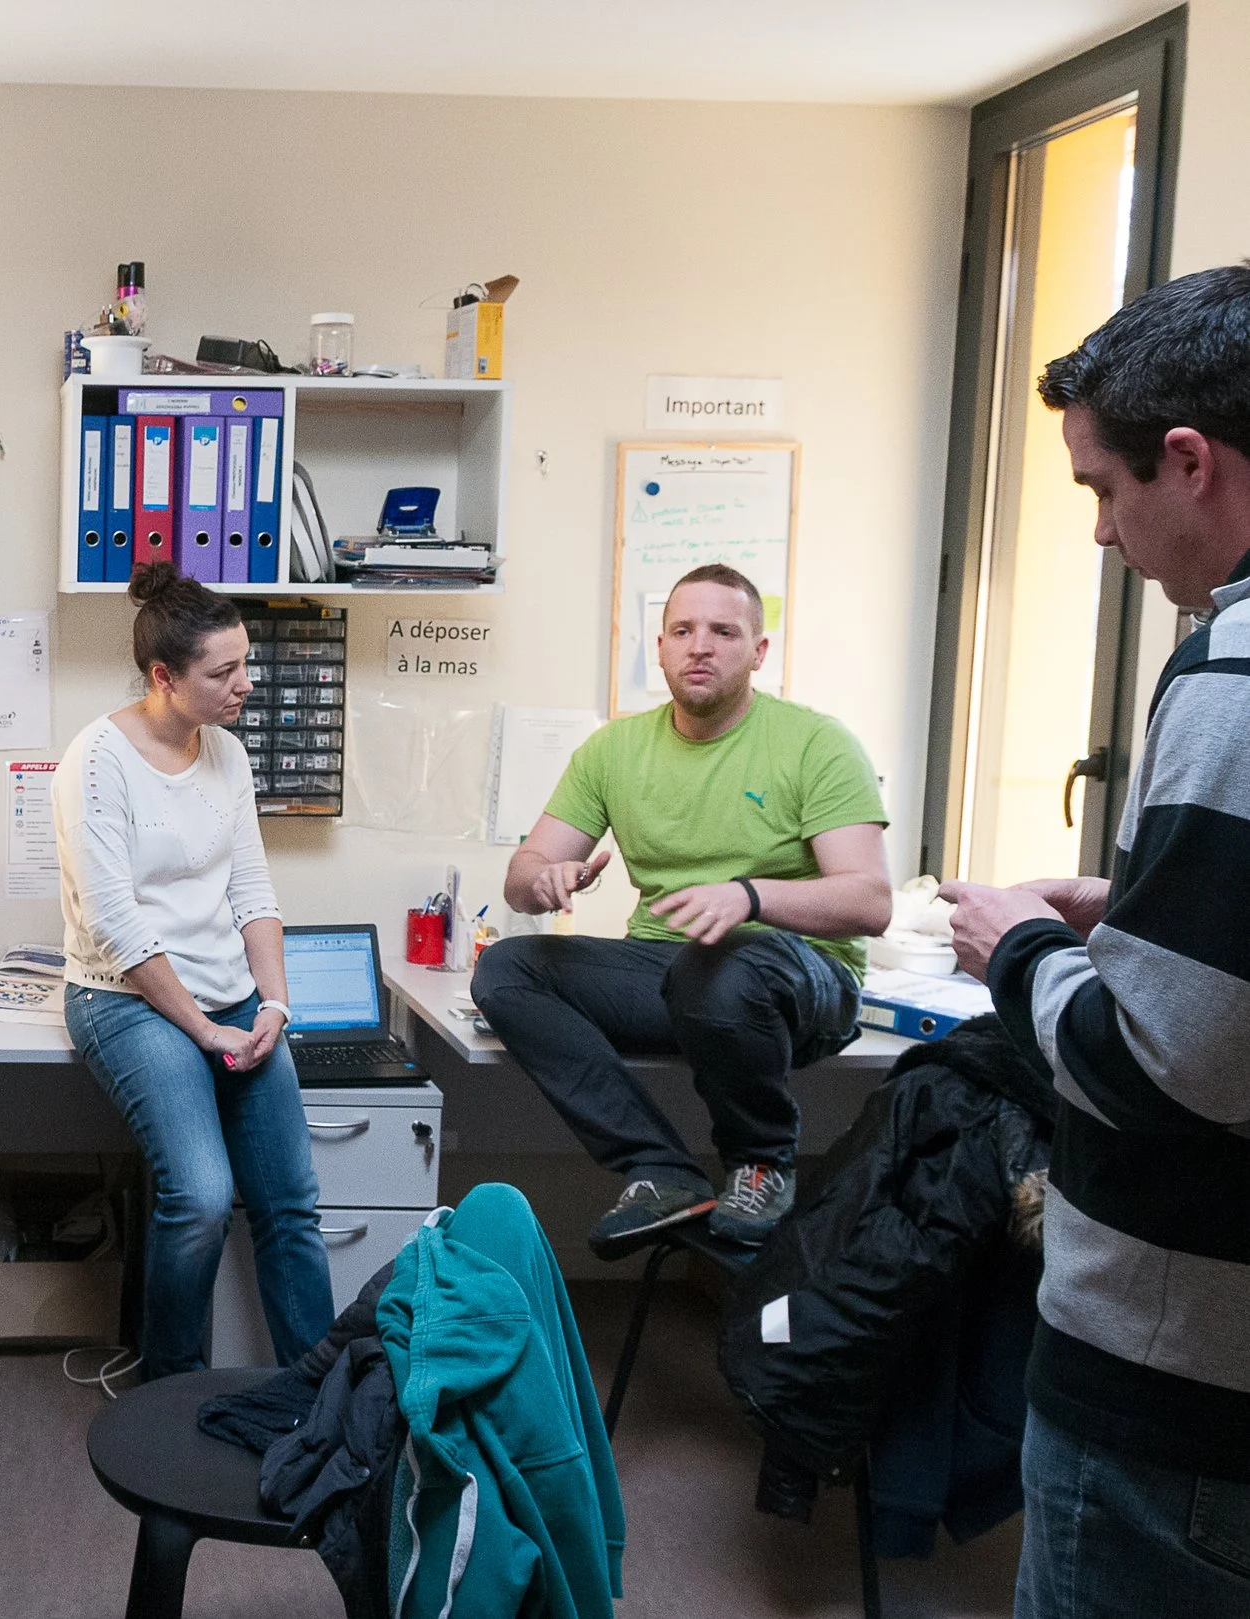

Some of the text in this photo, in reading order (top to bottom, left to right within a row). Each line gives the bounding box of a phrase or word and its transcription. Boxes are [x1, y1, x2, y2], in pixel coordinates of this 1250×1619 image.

[665, 396, 766, 417] Important
[390, 620, 490, 643] A déposer
[397, 654, 478, 675] à la mas
[21, 763, 48, 771] APPELS
